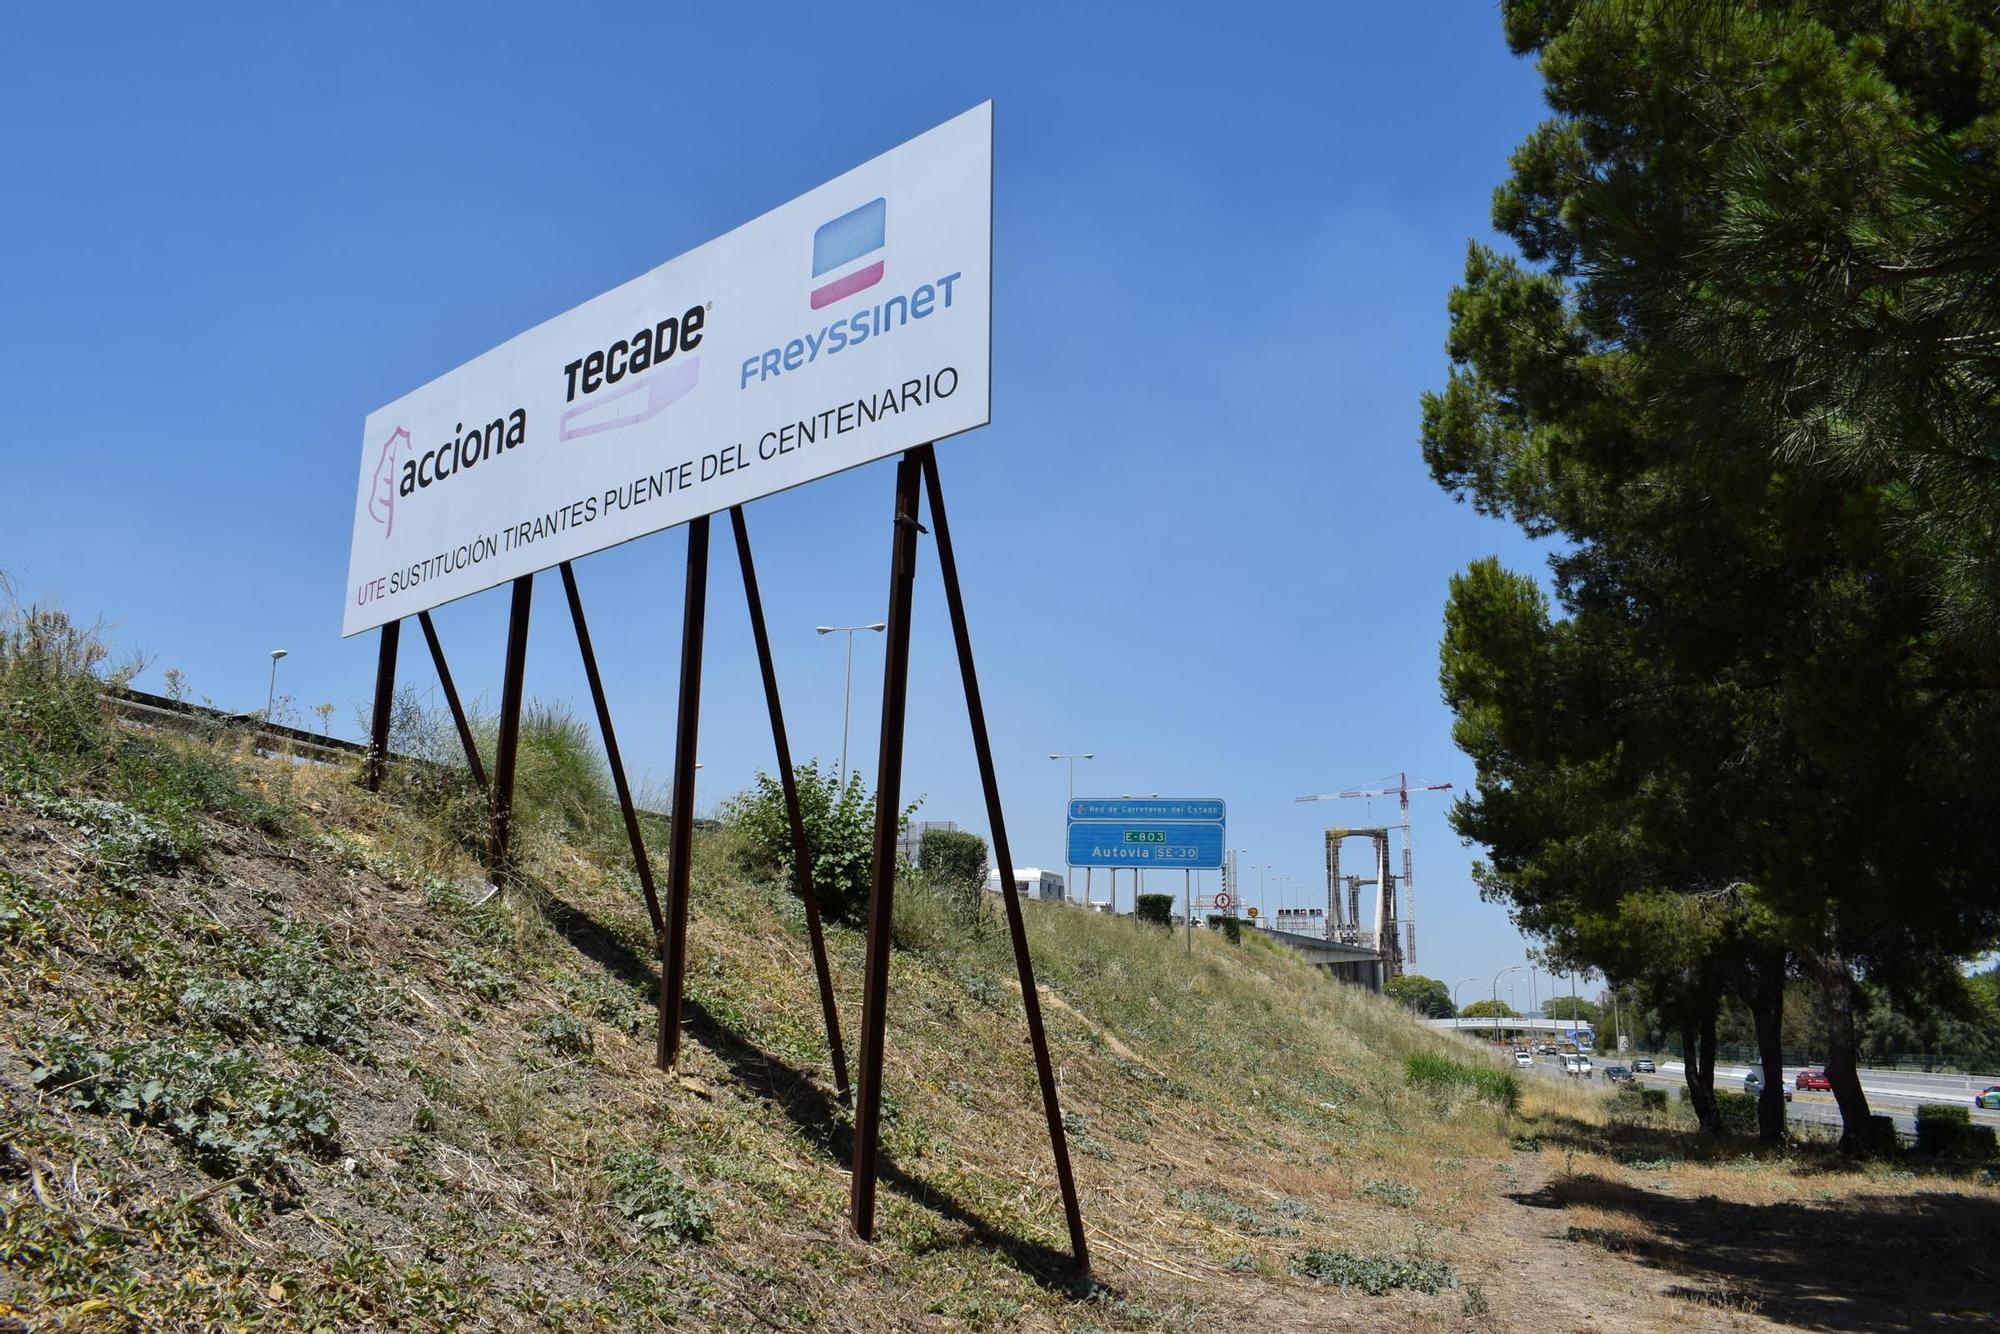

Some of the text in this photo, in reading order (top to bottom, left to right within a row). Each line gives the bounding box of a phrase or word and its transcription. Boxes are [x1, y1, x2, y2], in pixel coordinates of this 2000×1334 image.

[399, 407, 527, 498] acciona
[357, 366, 959, 607] UTE SUSTITUCIÓN TIRANTES PUENTE DEL CENTENARIO
[1089, 806, 1218, 814] Red de Carreteras del Estado
[1125, 832, 1165, 842] E-803
[1156, 847, 1196, 858] SE-30
